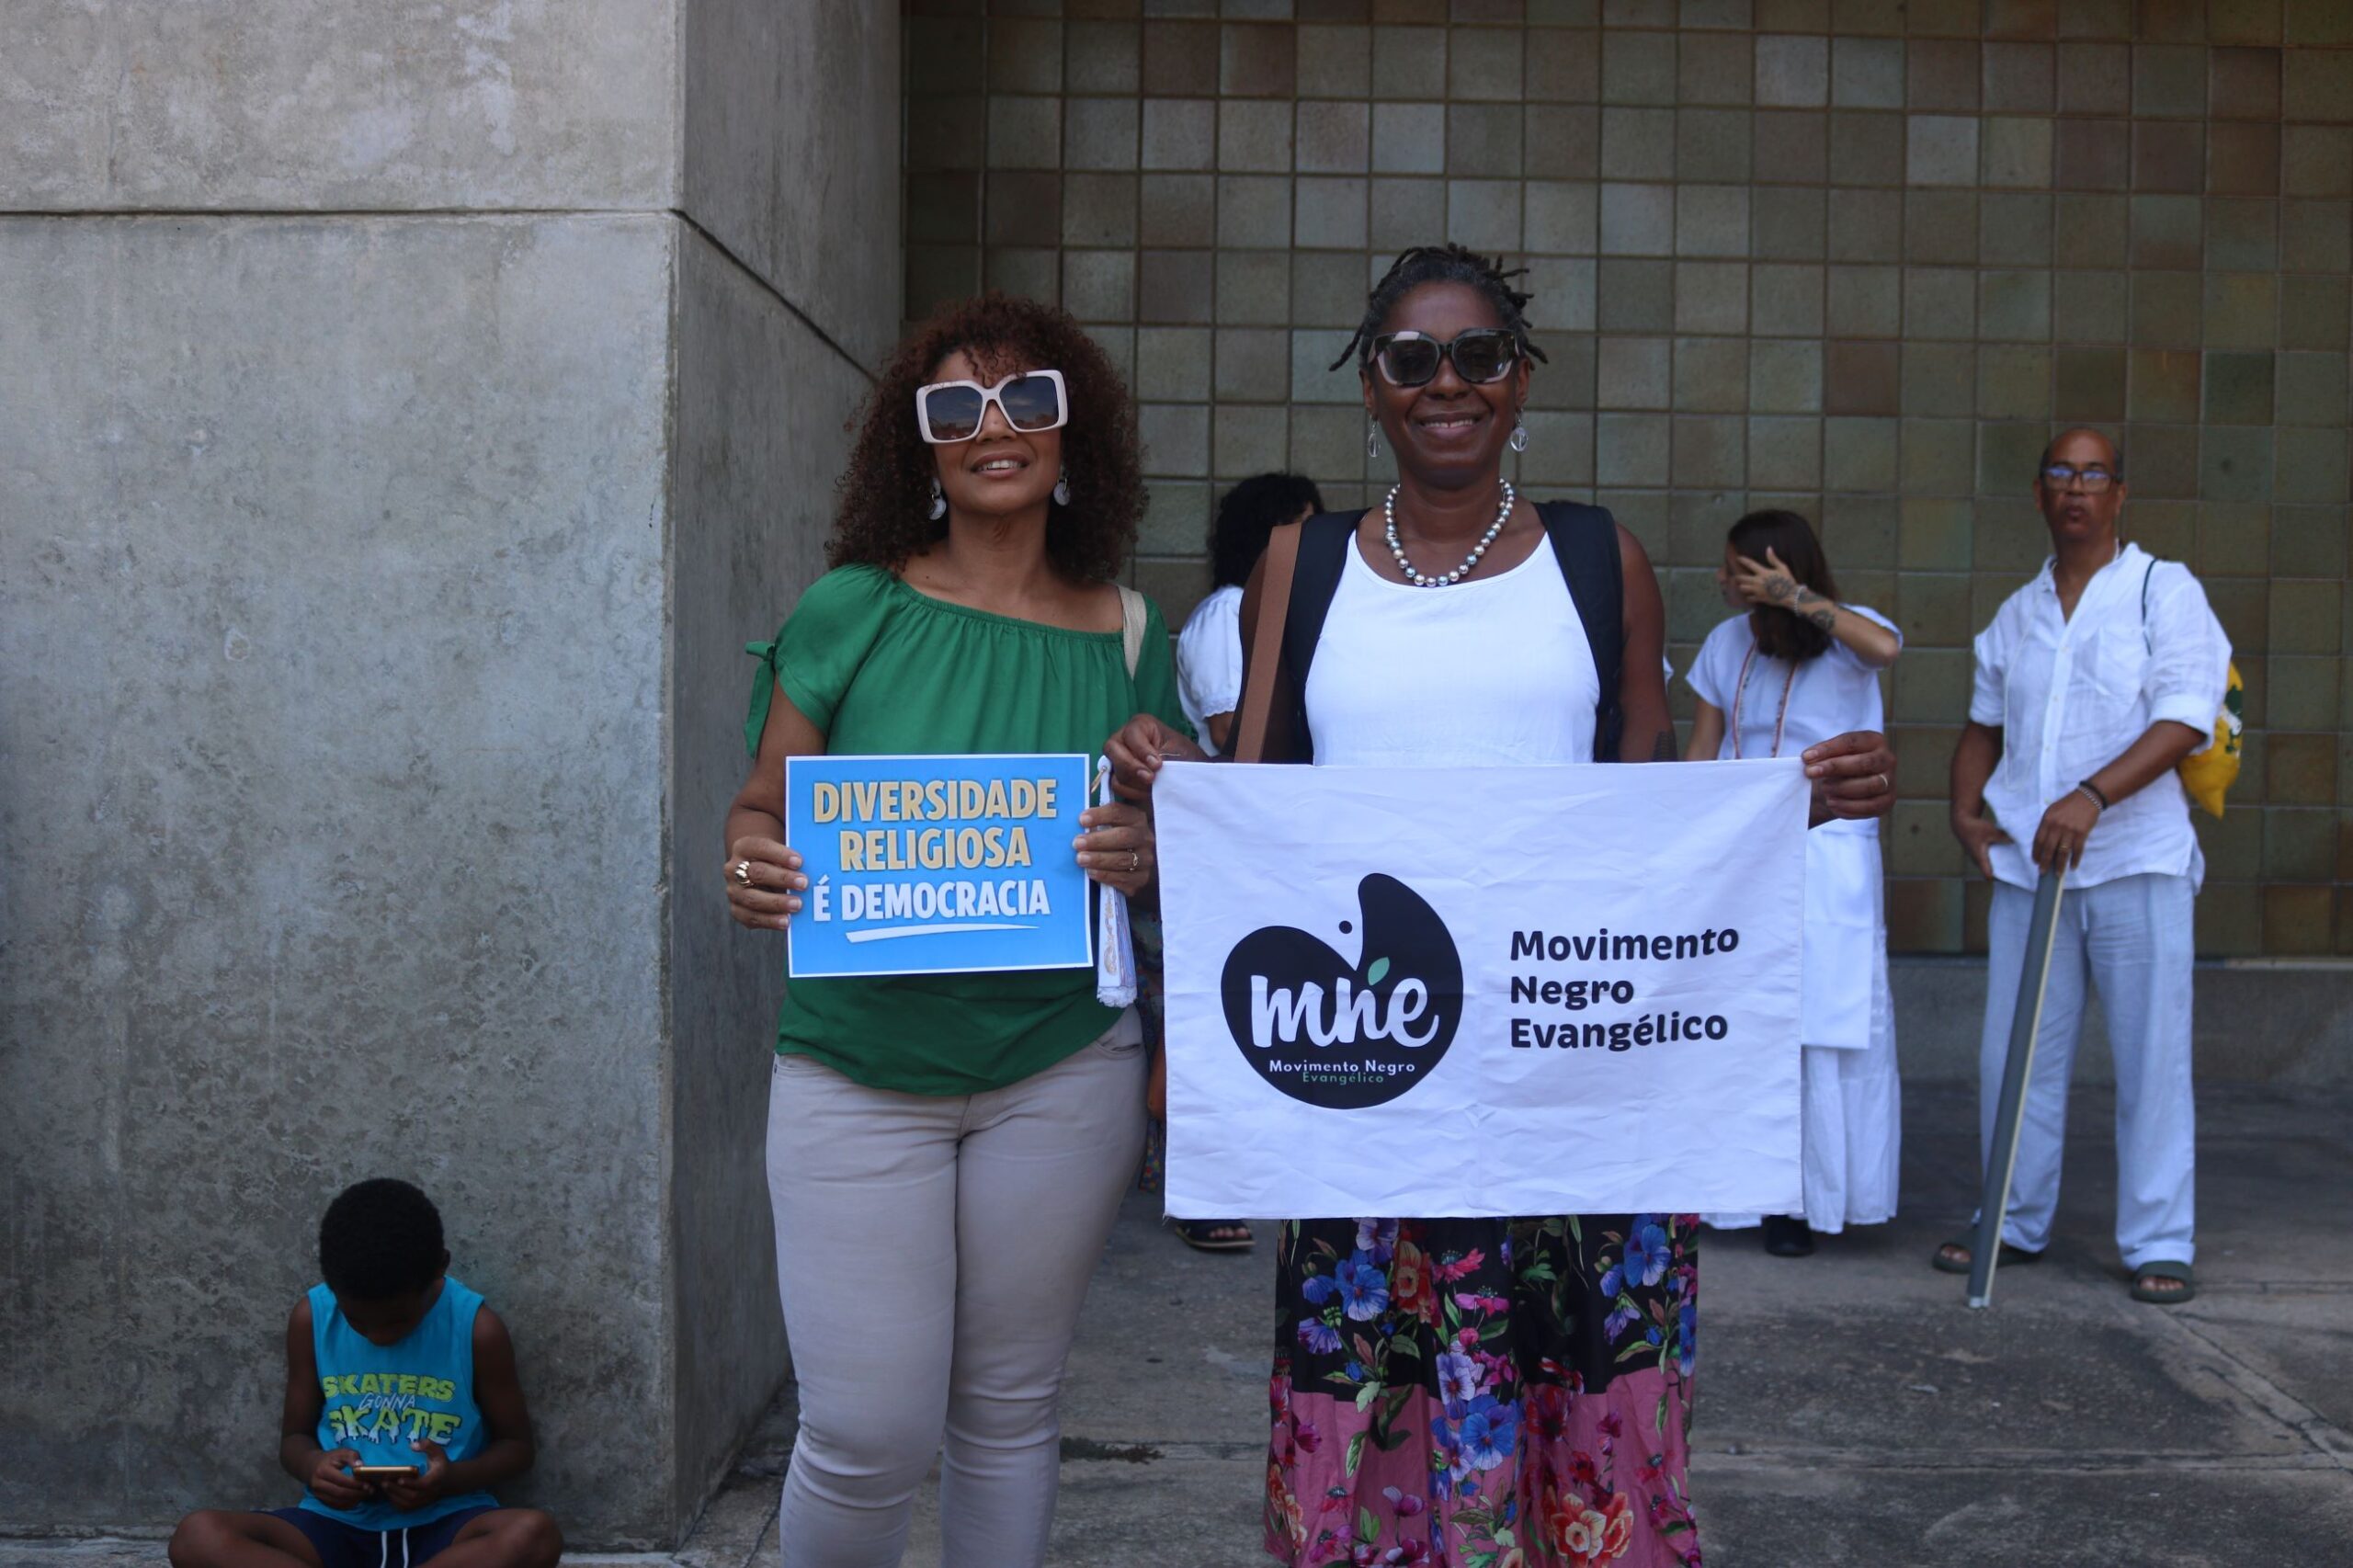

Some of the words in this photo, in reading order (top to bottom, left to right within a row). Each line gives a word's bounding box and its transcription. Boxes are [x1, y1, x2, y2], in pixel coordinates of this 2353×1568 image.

[813, 778, 1058, 824] DIVERSIDADE
[838, 826, 1032, 872] RELIGIOSA
[813, 875, 832, 922] É
[841, 880, 1051, 922] DEMOCRACIA
[1510, 927, 1740, 961] Movimento
[1250, 974, 1439, 1048] mne
[1510, 975, 1634, 1011] Negro
[1510, 1010, 1728, 1052] Evangélico
[1268, 1059, 1359, 1074] Movimento
[1365, 1059, 1415, 1076] Negro
[1302, 1071, 1384, 1085] Evangélico
[323, 1373, 456, 1403] SKATERS
[358, 1392, 416, 1411] GONNA
[328, 1404, 462, 1445] SKATE
